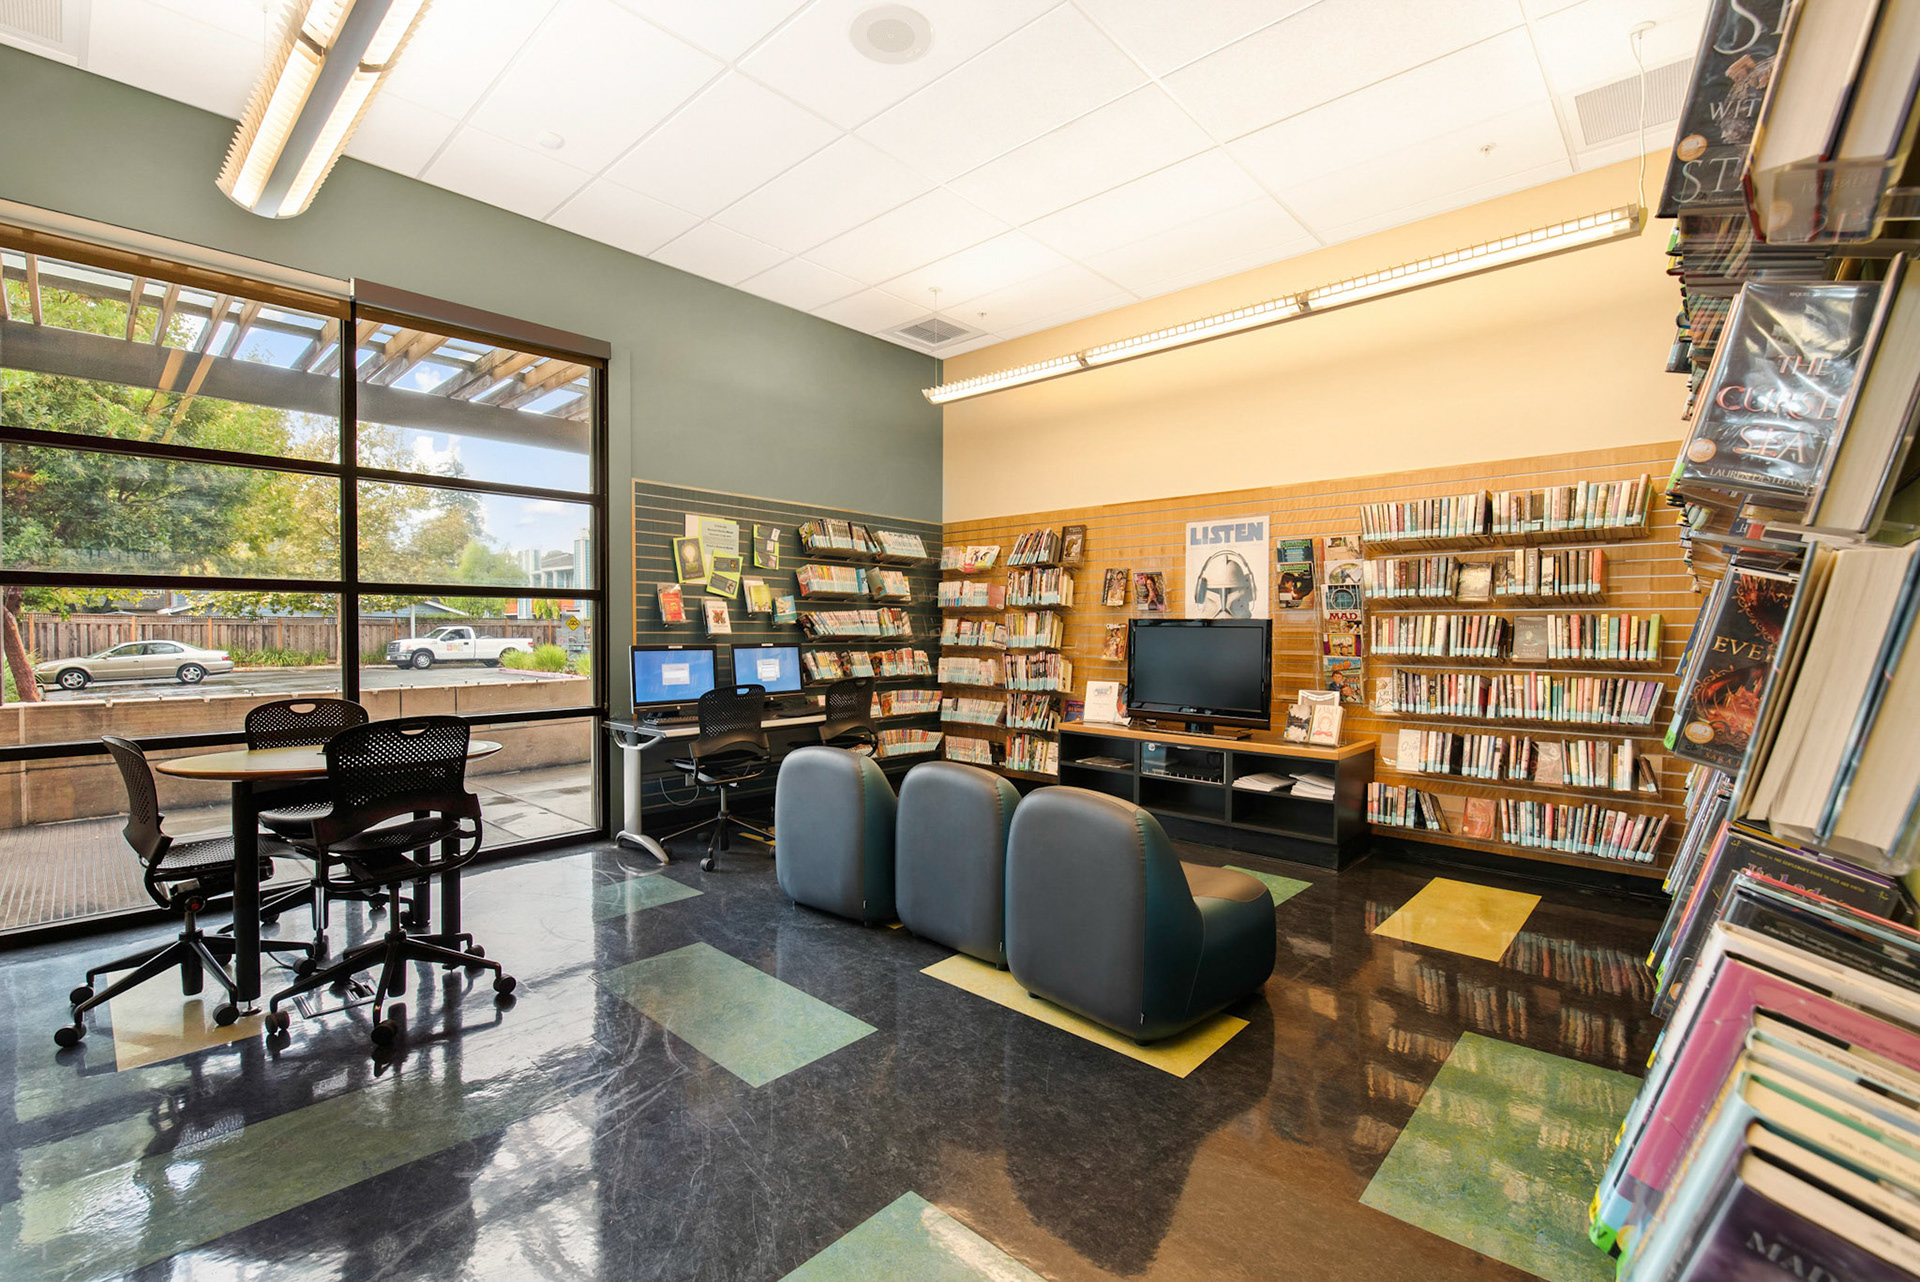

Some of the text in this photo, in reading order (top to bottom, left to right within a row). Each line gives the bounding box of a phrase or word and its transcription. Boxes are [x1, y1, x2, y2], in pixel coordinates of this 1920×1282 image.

[1778, 354, 1829, 376] THE
[1191, 522, 1263, 545] LISTEN
[1329, 612, 1358, 620] MAD
